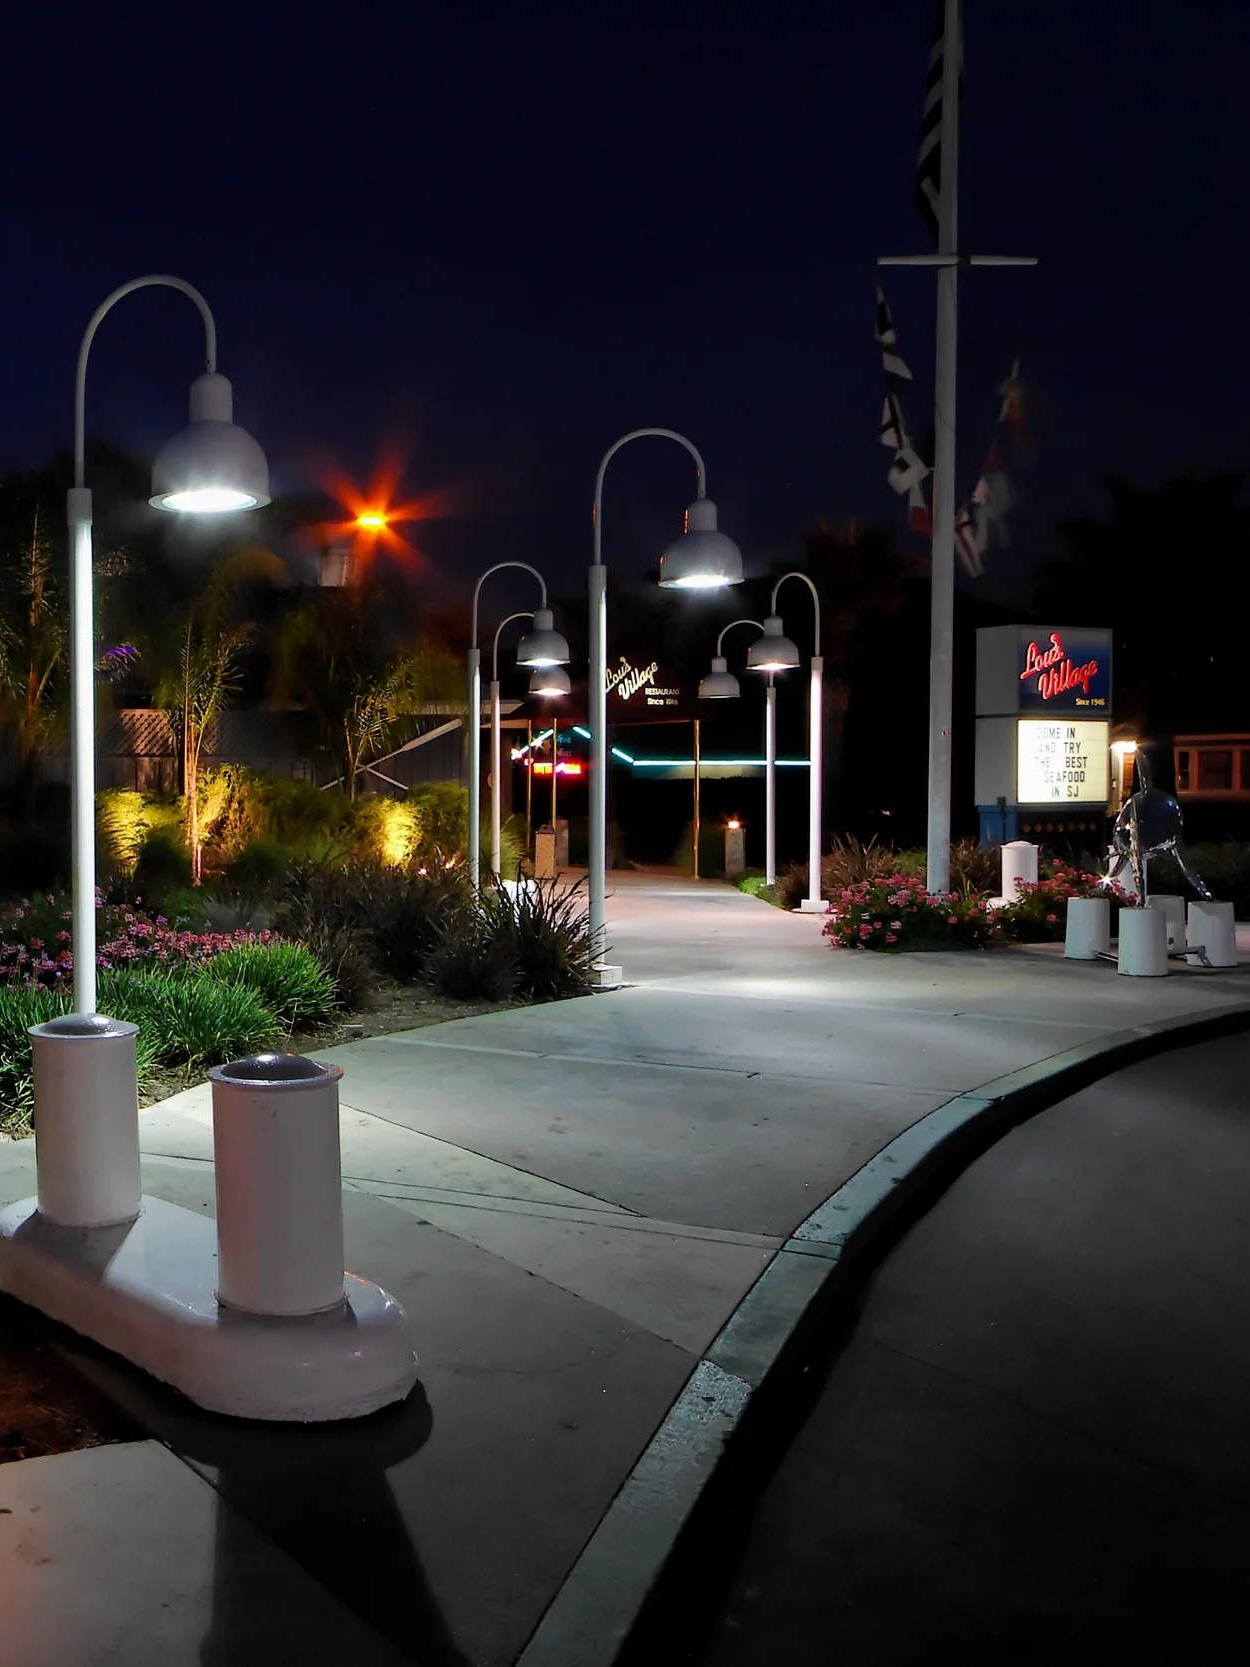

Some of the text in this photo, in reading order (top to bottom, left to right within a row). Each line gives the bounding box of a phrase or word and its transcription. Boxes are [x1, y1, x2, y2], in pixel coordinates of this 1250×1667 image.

[1019, 633, 1065, 680] Lou's
[606, 656, 631, 693] Lou's
[618, 661, 658, 700] Village
[1038, 660, 1099, 700] Village
[644, 687, 680, 695] RESTAURANT
[647, 697, 664, 705] Since
[1075, 697, 1105, 706] Since 1946
[1066, 727, 1076, 739] IN
[1063, 742, 1081, 754] TRY
[1065, 756, 1088, 768] BEST
[1044, 770, 1085, 783] SEAFOOD
[1051, 785, 1079, 797] IN SJ
